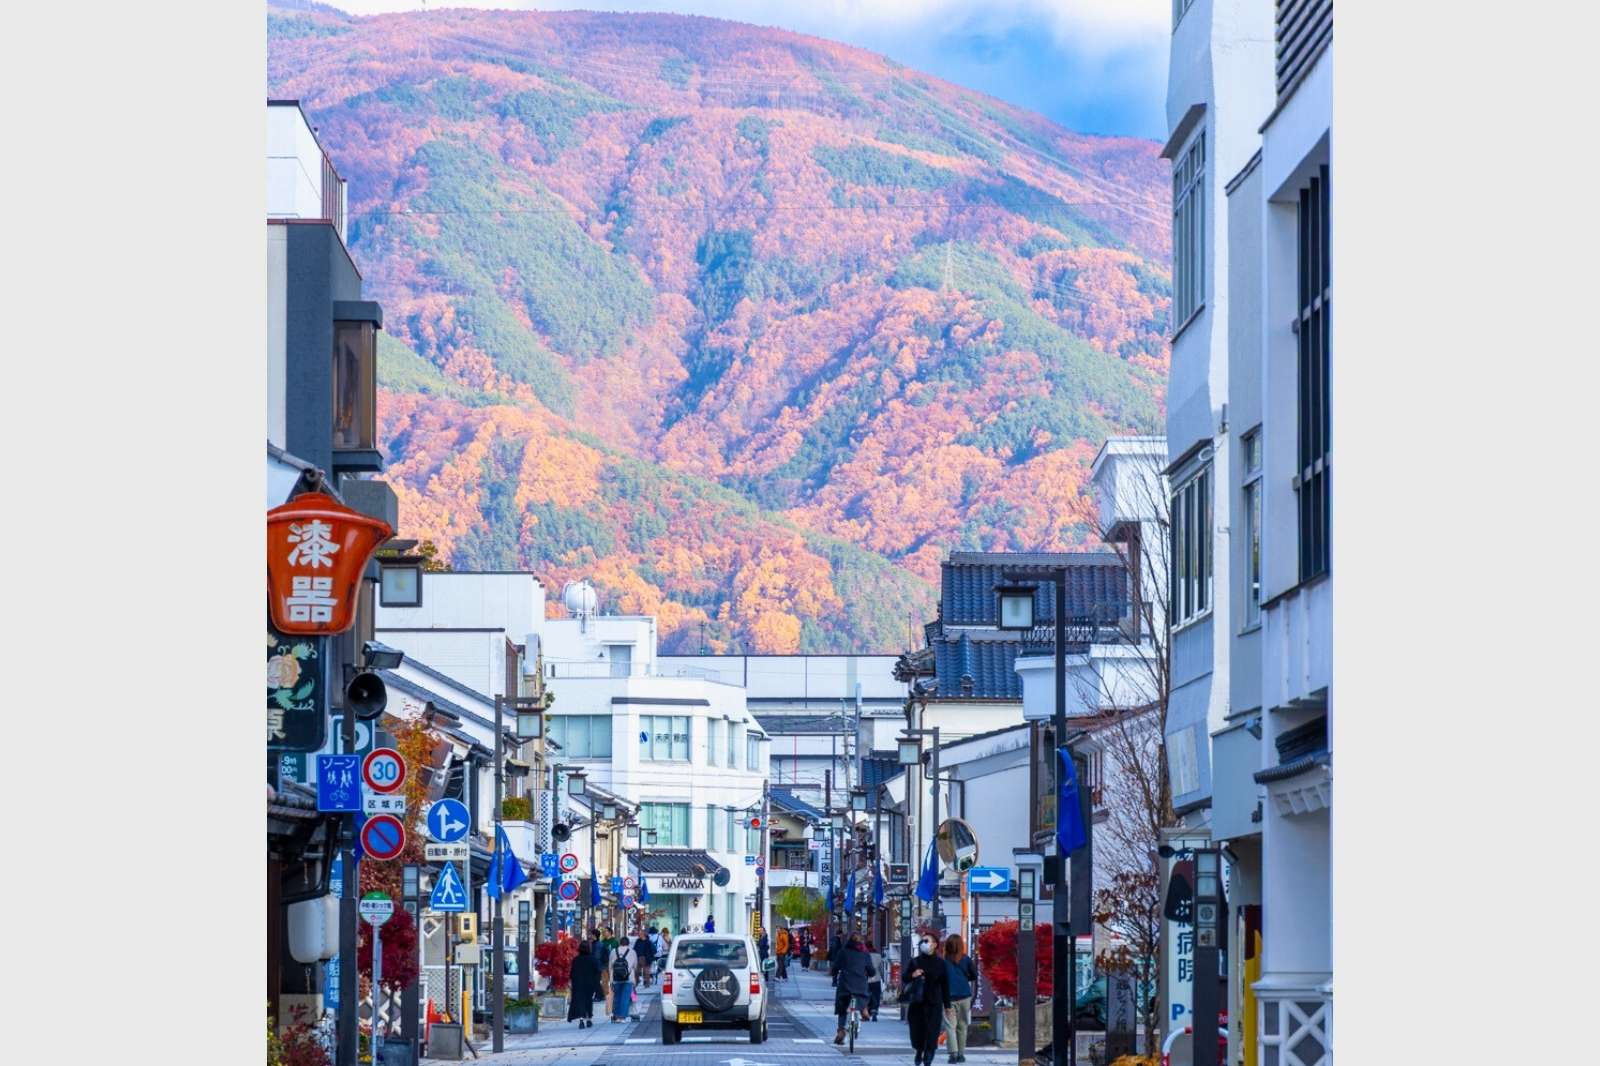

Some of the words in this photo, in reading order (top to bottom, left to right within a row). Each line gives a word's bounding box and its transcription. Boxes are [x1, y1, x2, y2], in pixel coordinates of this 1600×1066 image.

[287, 519, 340, 623] 漆器
[373, 761, 397, 781] 30
[368, 799, 404, 809] 区域内
[661, 878, 704, 888] HAYAMA
[1172, 1003, 1185, 1020] P
